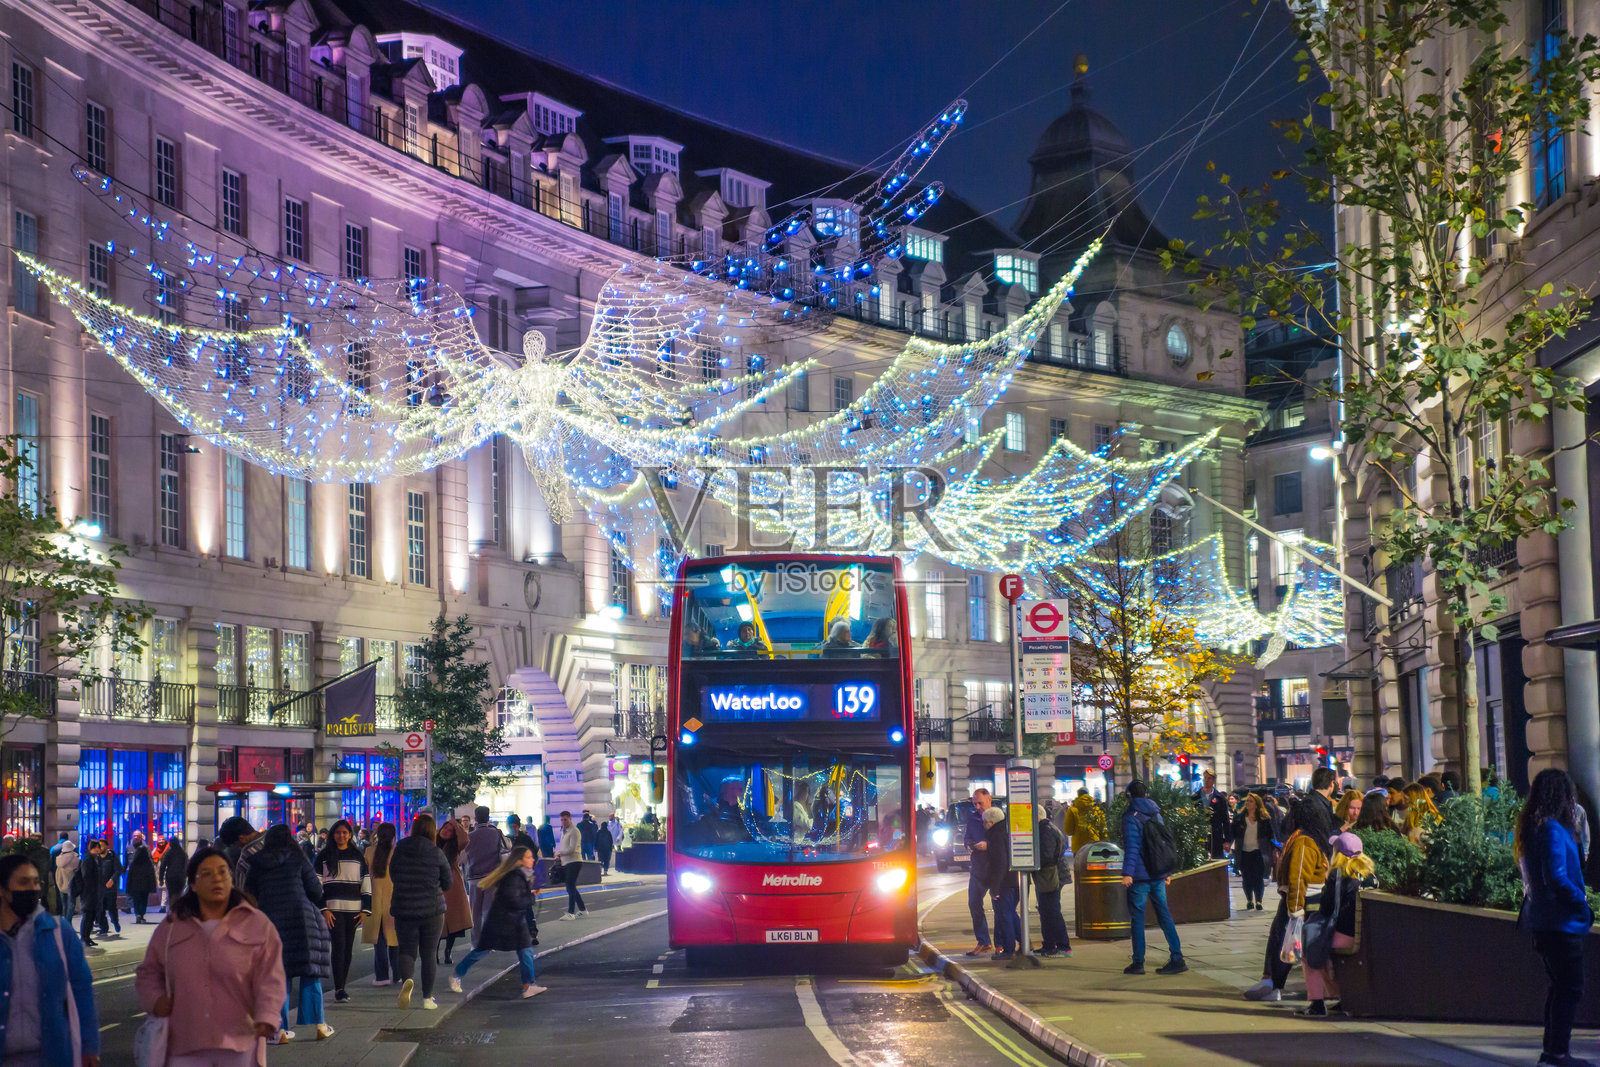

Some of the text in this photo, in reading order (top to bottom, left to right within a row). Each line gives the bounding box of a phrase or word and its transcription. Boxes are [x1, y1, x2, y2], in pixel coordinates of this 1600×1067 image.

[1006, 578, 1018, 596] F
[711, 693, 802, 711] Waterloo
[837, 686, 875, 713] 139
[327, 723, 374, 735] HOLLISTER
[425, 720, 431, 730] E
[762, 874, 822, 886] Metroline
[771, 932, 813, 941] LK61 BLN
